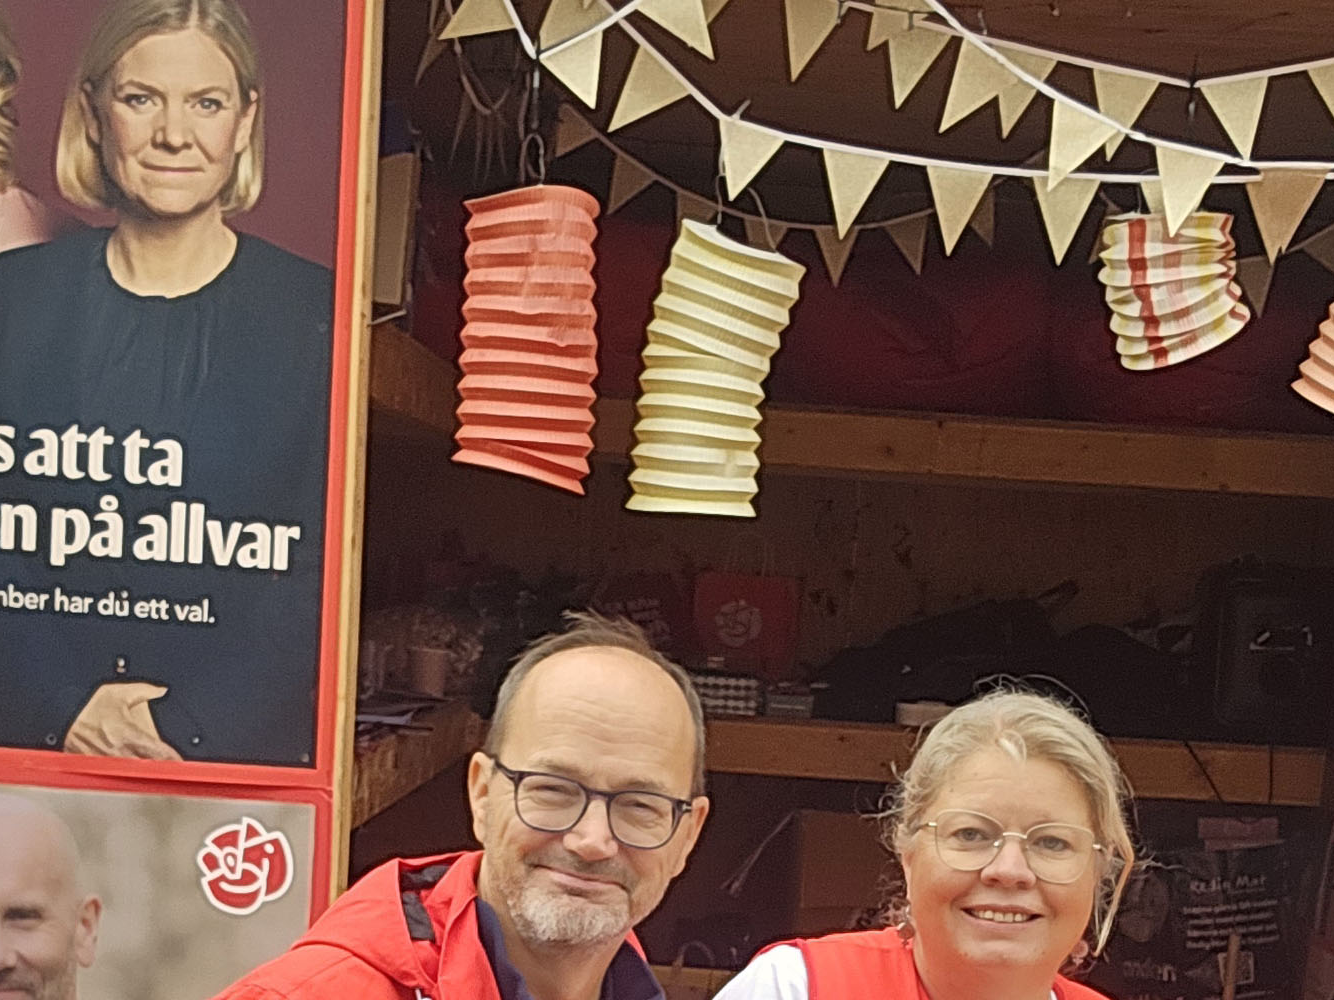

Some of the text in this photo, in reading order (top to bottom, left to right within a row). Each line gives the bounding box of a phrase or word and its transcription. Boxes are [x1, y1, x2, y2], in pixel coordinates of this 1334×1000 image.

[24, 423, 114, 483] att
[122, 429, 183, 487] ta
[50, 494, 124, 566] på
[133, 500, 301, 571] allvar
[54, 587, 94, 613] har
[97, 592, 130, 616] du
[134, 599, 169, 621] ett
[173, 599, 215, 623] val.
